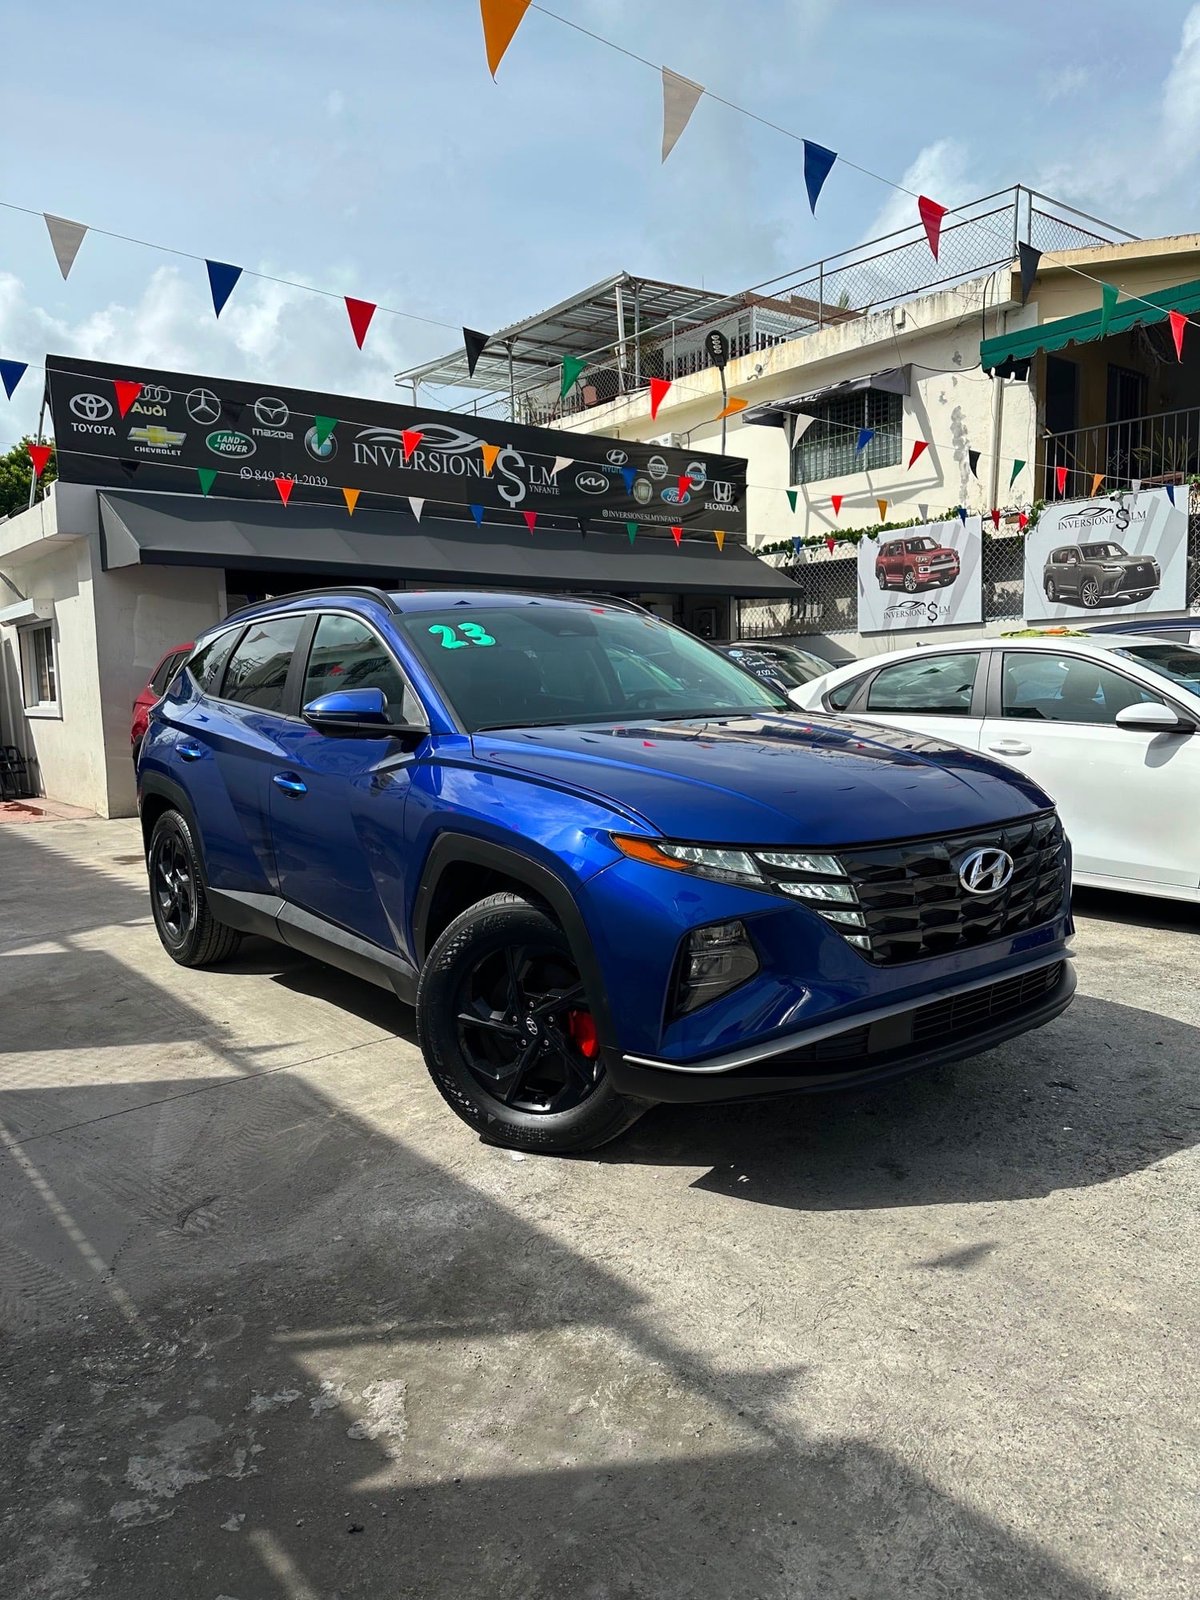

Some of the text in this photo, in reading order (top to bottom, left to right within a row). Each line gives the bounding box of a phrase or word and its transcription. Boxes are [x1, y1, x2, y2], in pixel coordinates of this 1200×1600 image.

[131, 402, 167, 417] Audi
[71, 422, 117, 436] TOYOTA
[217, 434, 241, 444] LAND
[134, 446, 182, 456] CHEVROLET
[219, 443, 248, 453] ROVER
[528, 465, 559, 486] LM
[529, 484, 560, 495] YNFANTE
[704, 503, 740, 513] HONDA
[1131, 511, 1147, 520] LM
[428, 622, 496, 649] 23
